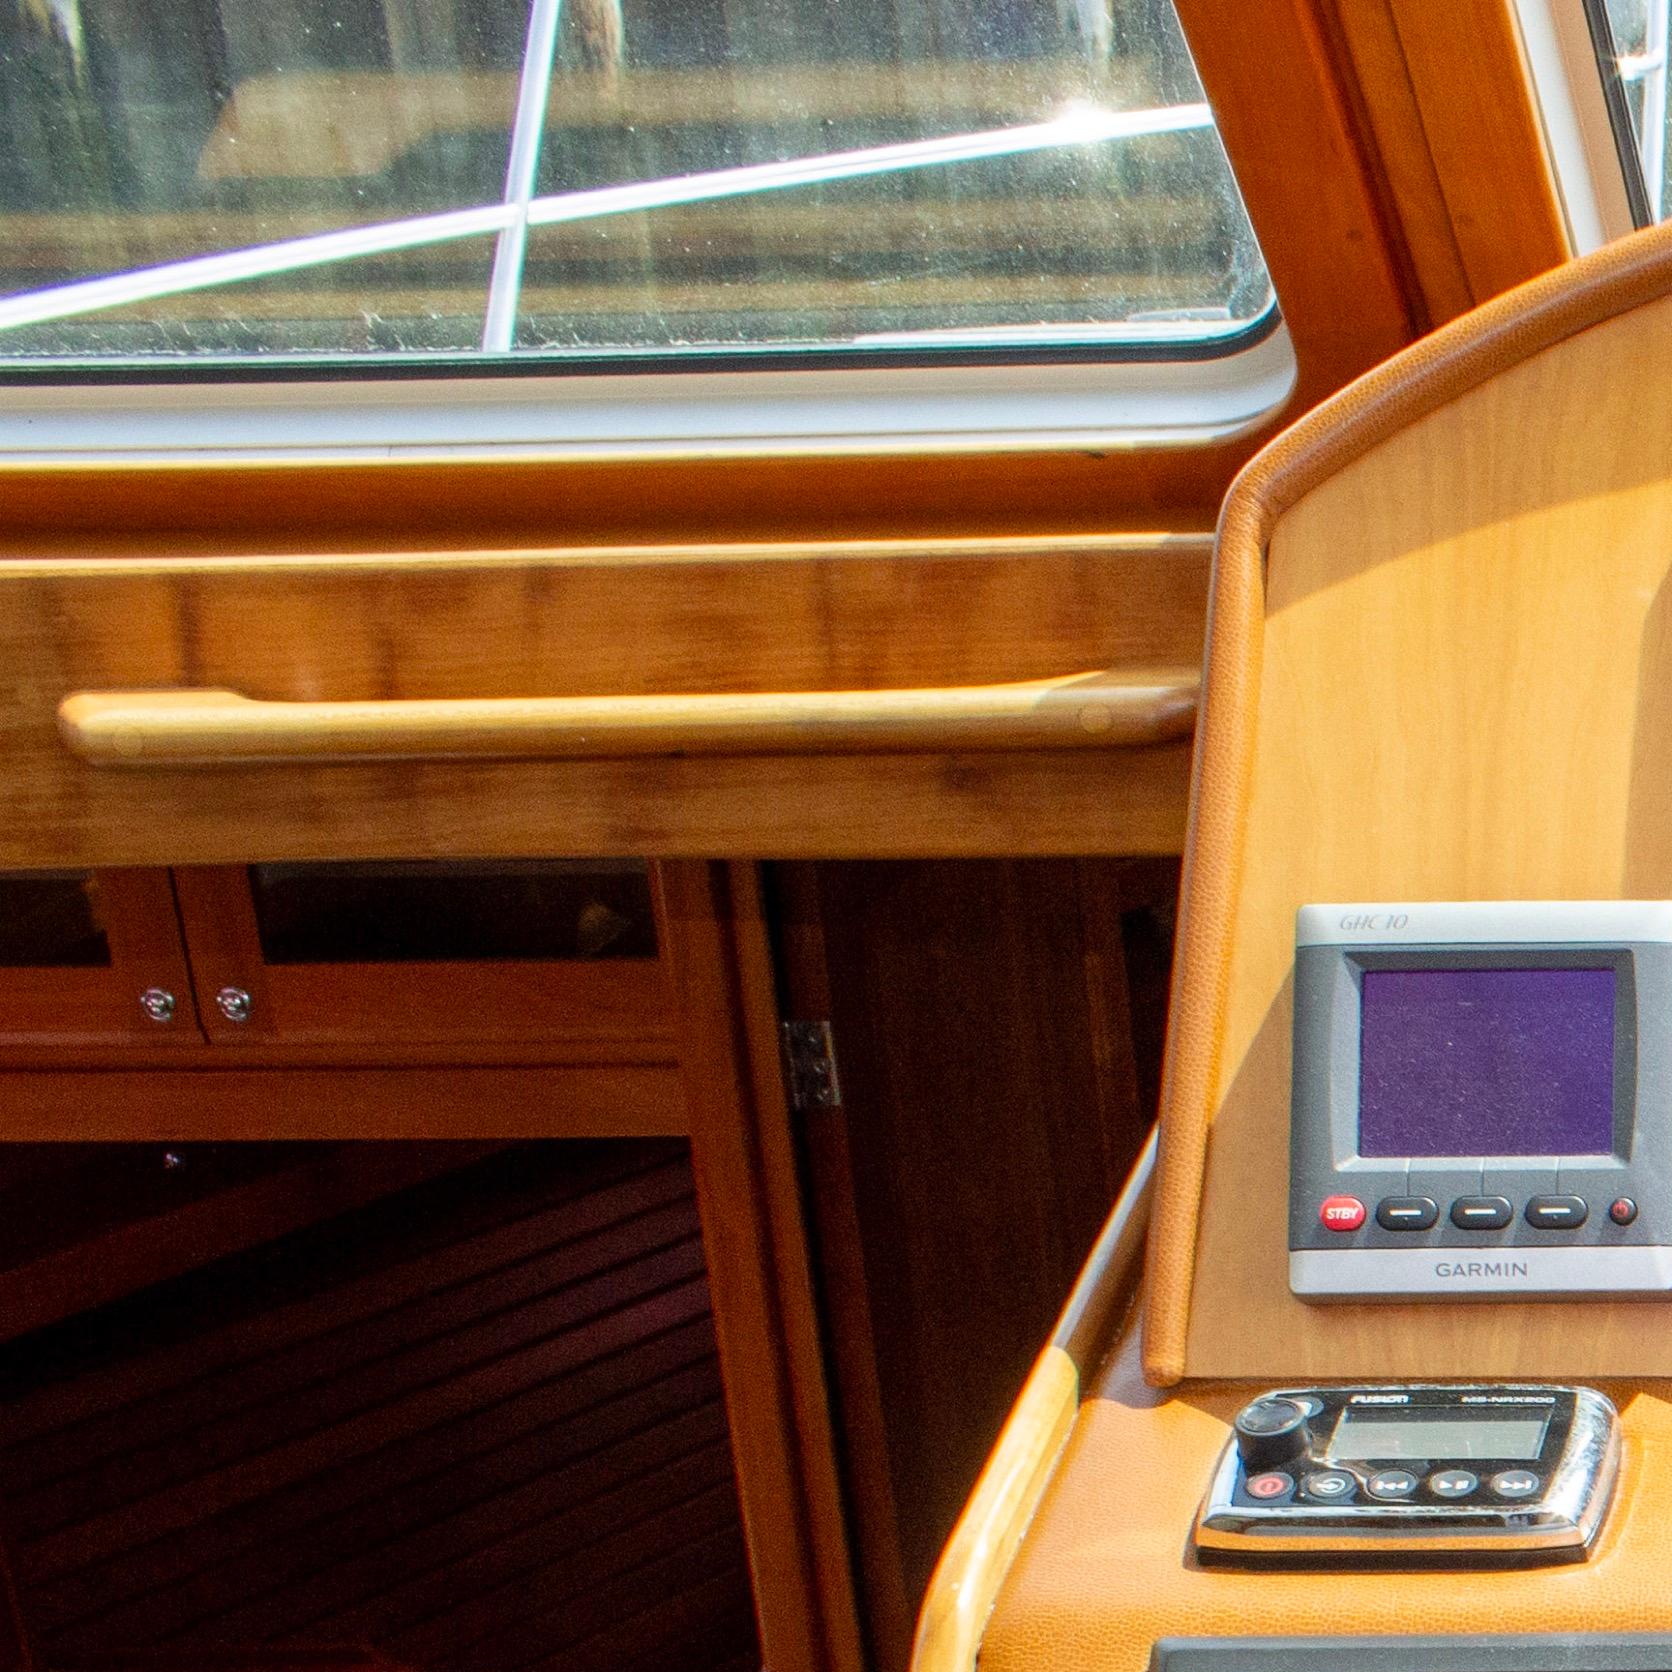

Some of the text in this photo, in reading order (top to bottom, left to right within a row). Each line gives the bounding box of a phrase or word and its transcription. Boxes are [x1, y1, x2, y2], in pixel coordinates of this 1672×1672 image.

[1385, 914, 1409, 930] 10
[1325, 1206, 1360, 1220] STBY
[1435, 1261, 1529, 1278] GARMIN
